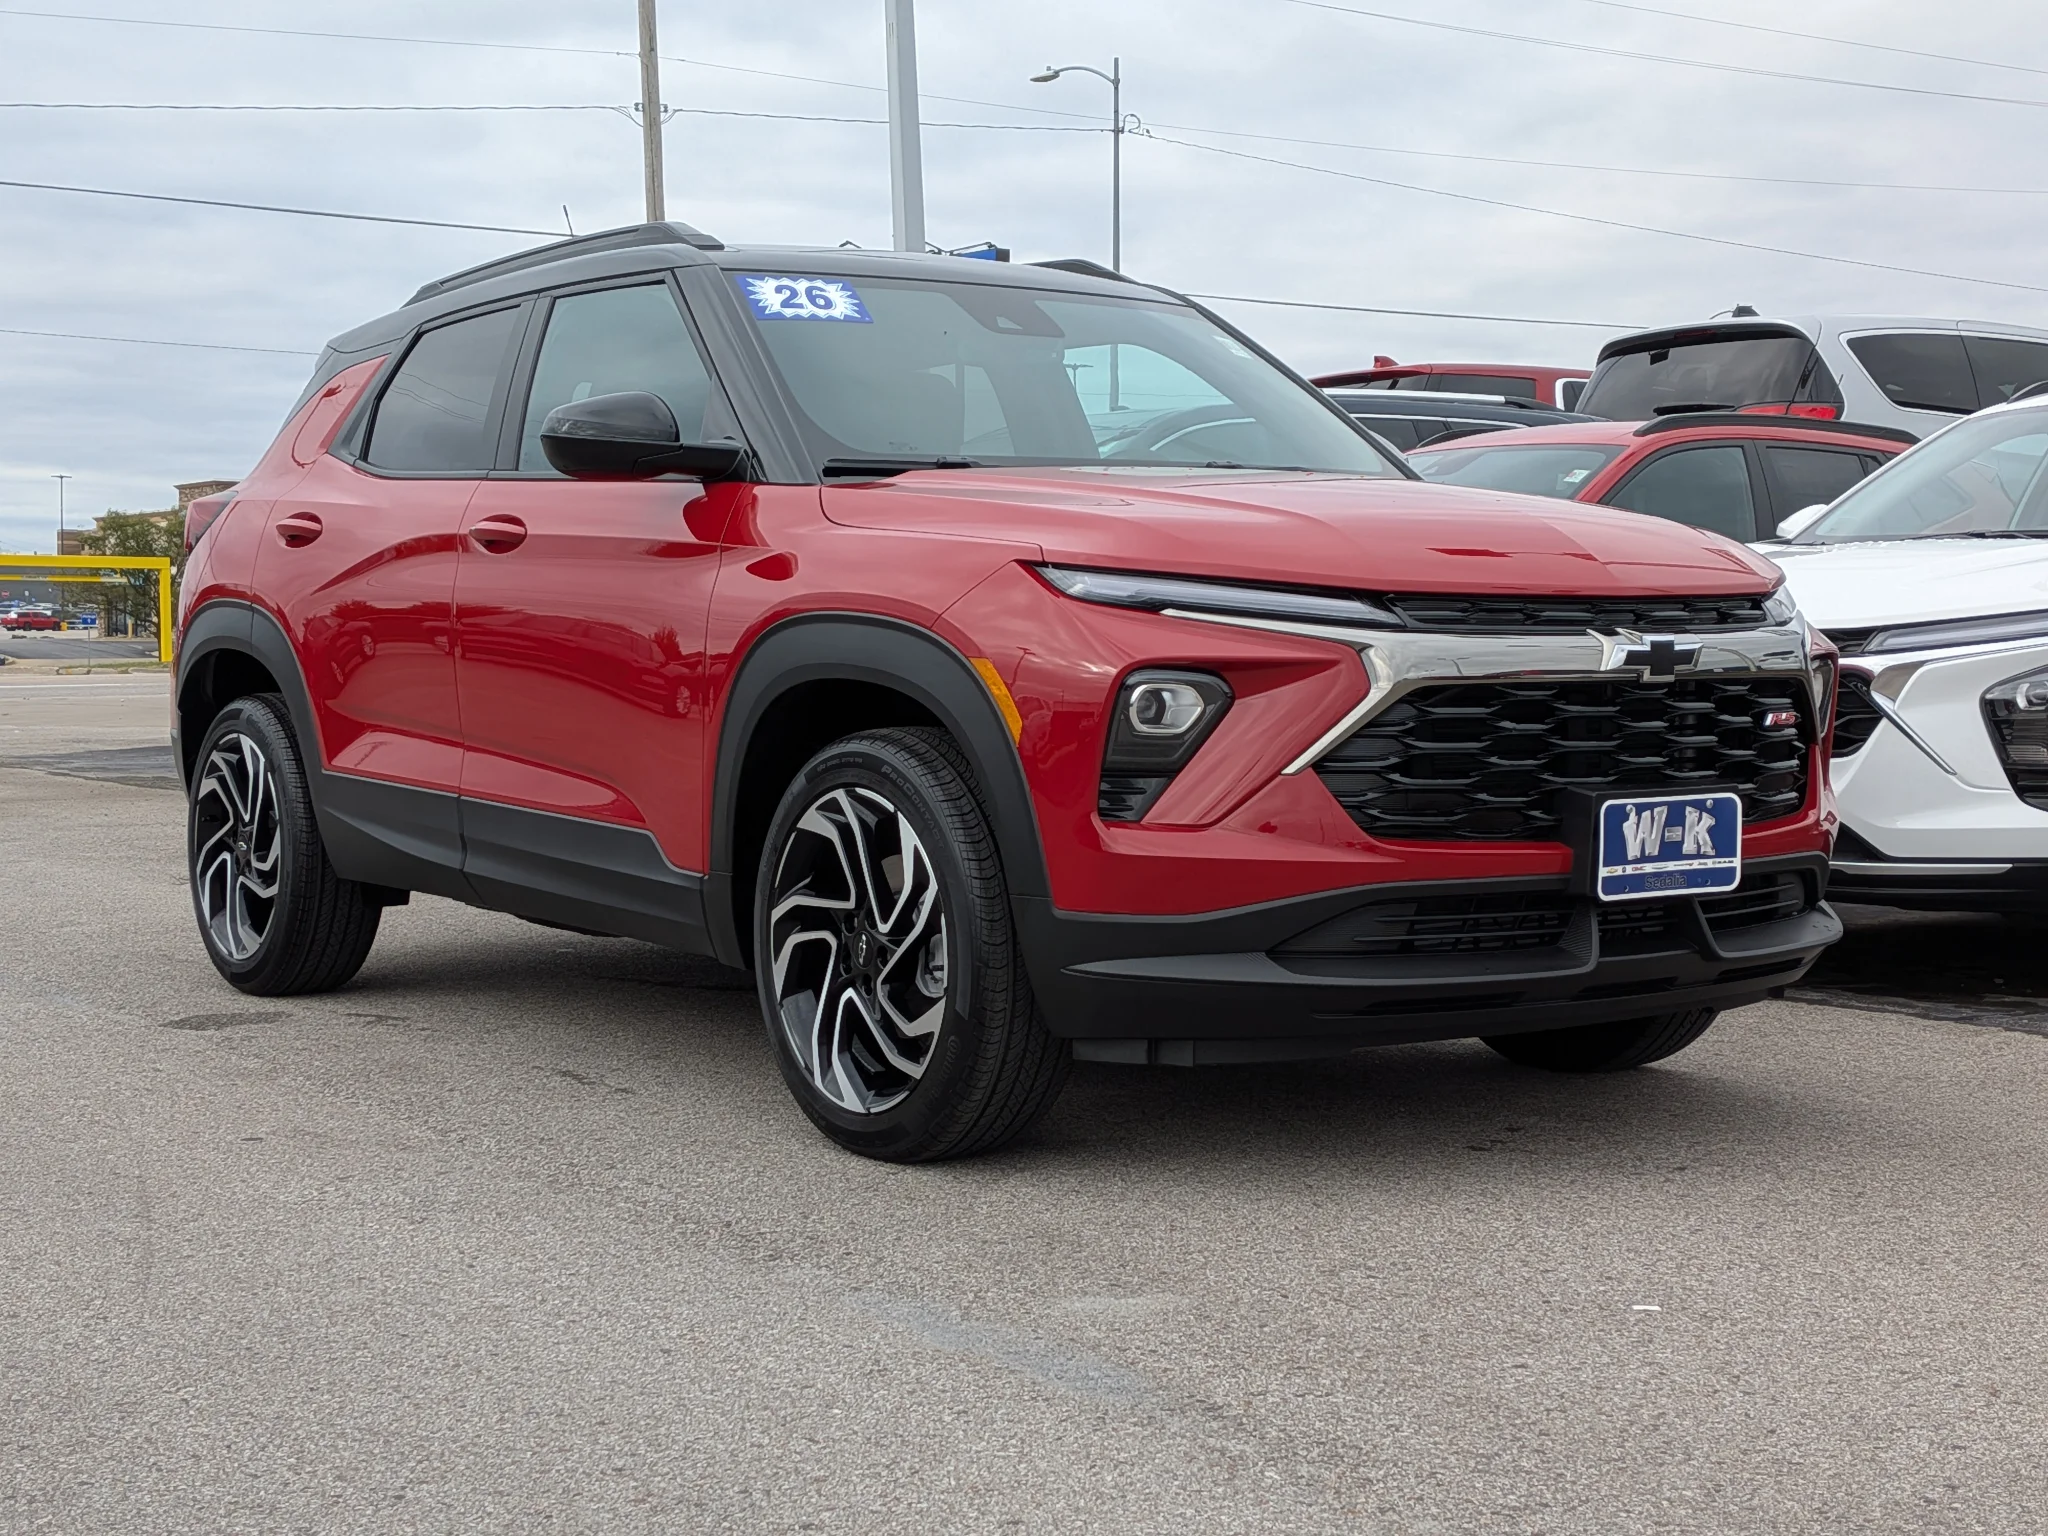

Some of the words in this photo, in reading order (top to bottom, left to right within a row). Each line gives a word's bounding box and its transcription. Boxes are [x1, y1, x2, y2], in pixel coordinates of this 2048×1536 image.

[774, 284, 834, 310] 26
[1765, 712, 1796, 726] RS
[1622, 805, 1716, 861] W-K
[1645, 874, 1687, 889] Sedalia
